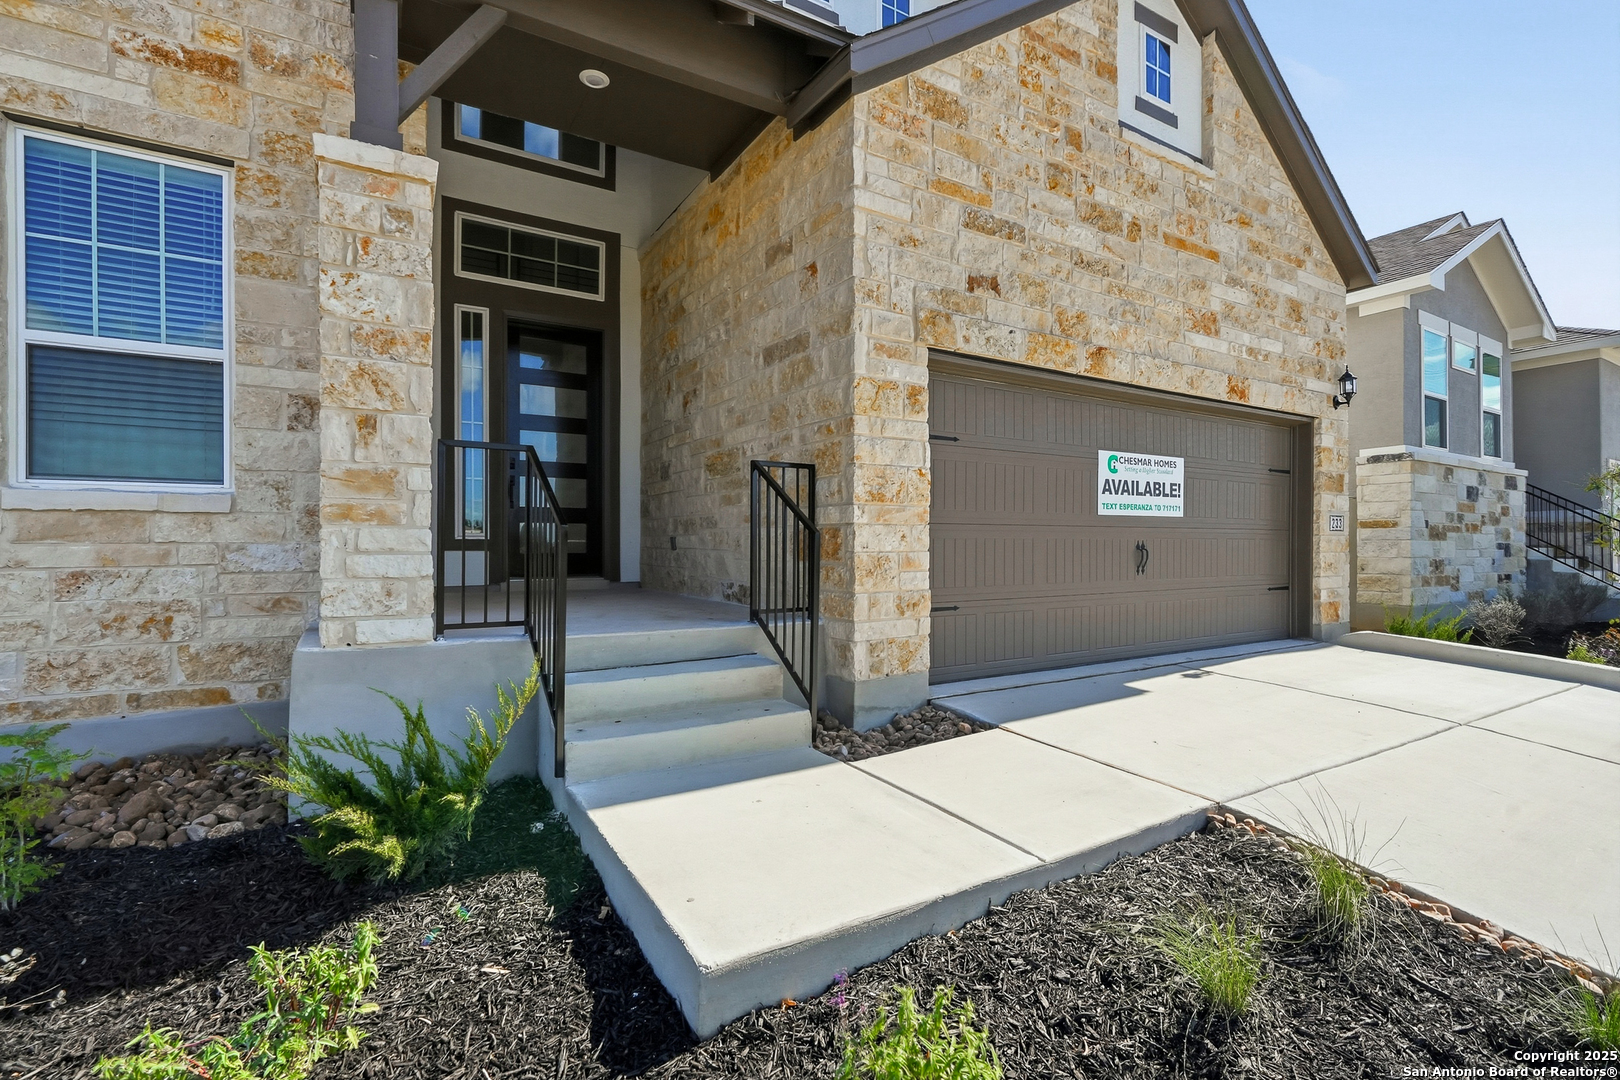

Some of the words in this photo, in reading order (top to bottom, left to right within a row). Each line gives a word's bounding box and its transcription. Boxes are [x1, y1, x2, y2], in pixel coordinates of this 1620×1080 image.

[1118, 456, 1152, 467] CHESMAR
[1153, 459, 1177, 469] HOMES
[1101, 478, 1181, 498] AVAILABLE!
[1101, 502, 1118, 510] TEXT
[1119, 503, 1153, 511] ESPERANZA
